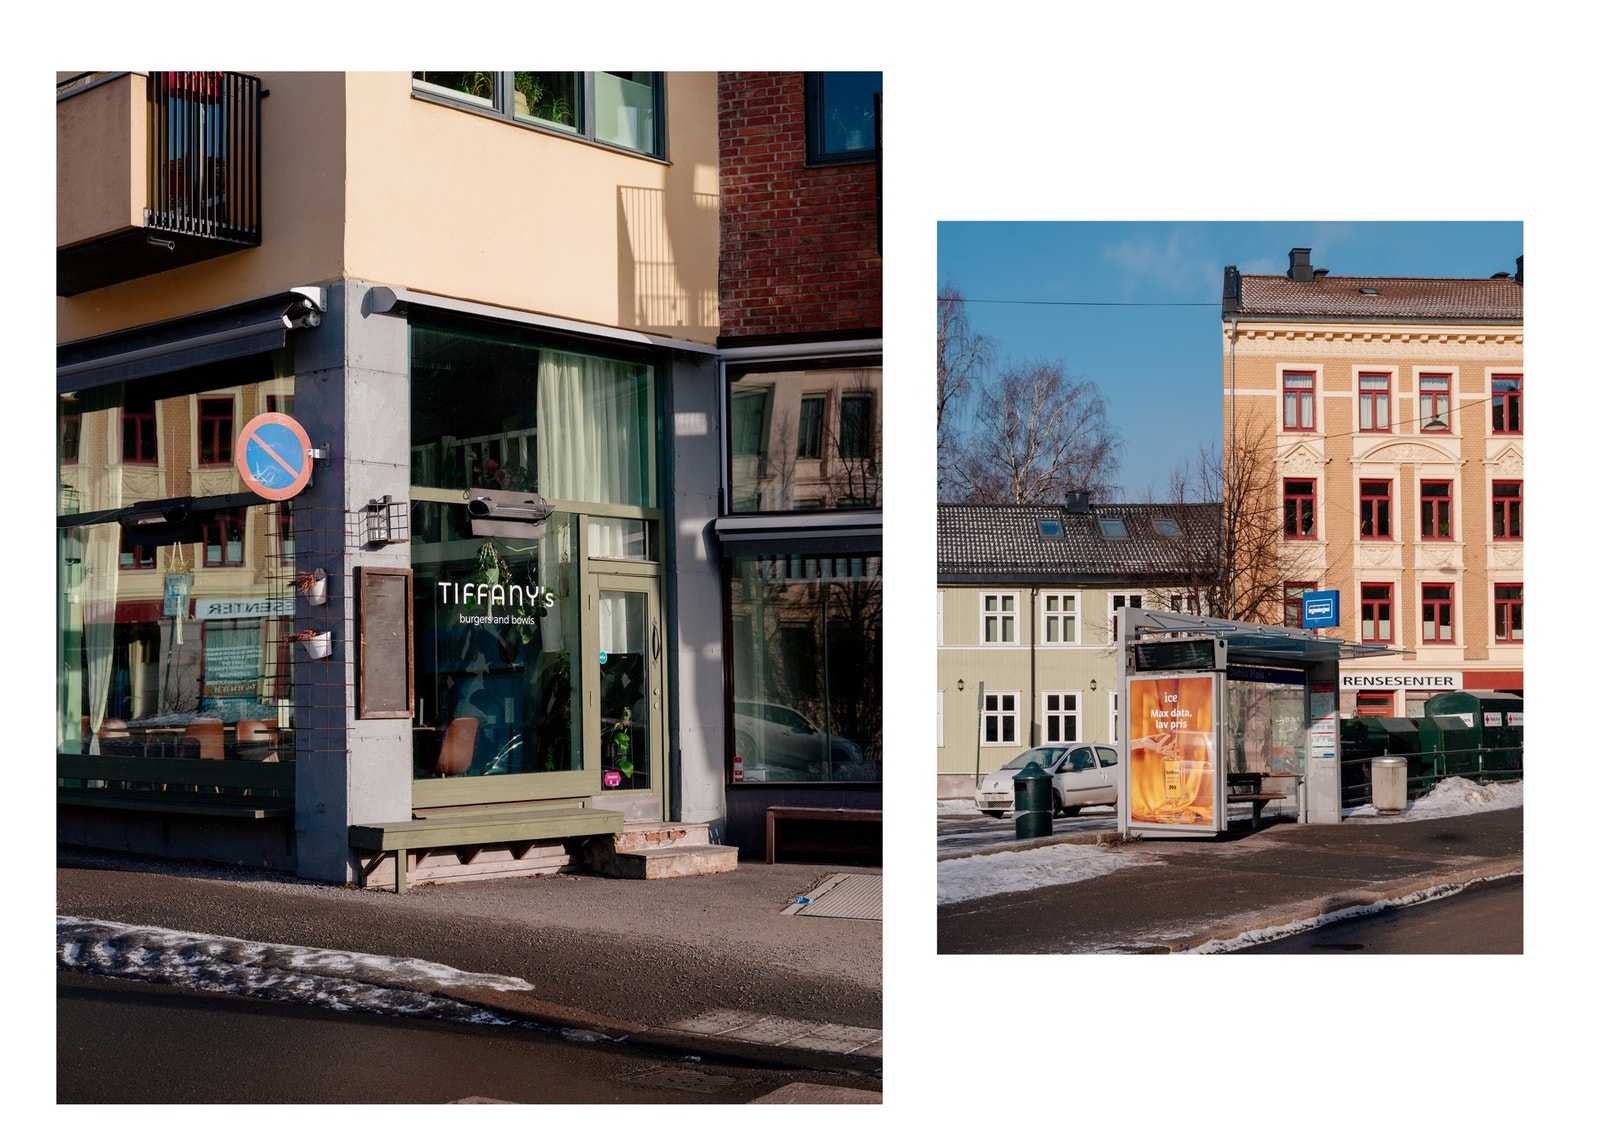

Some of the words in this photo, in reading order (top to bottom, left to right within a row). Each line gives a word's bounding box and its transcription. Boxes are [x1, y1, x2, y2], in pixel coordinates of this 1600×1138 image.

[438, 581, 554, 608] TIFFANY's
[459, 613, 492, 626] burgers
[494, 614, 510, 625] and
[511, 615, 535, 625] bowls
[1343, 676, 1454, 686] RENSESENTER
[1164, 691, 1178, 703] ice
[1150, 709, 1169, 718] Max
[1170, 708, 1193, 719] data,
[1155, 719, 1169, 729] lav
[1170, 718, 1188, 731] pris
